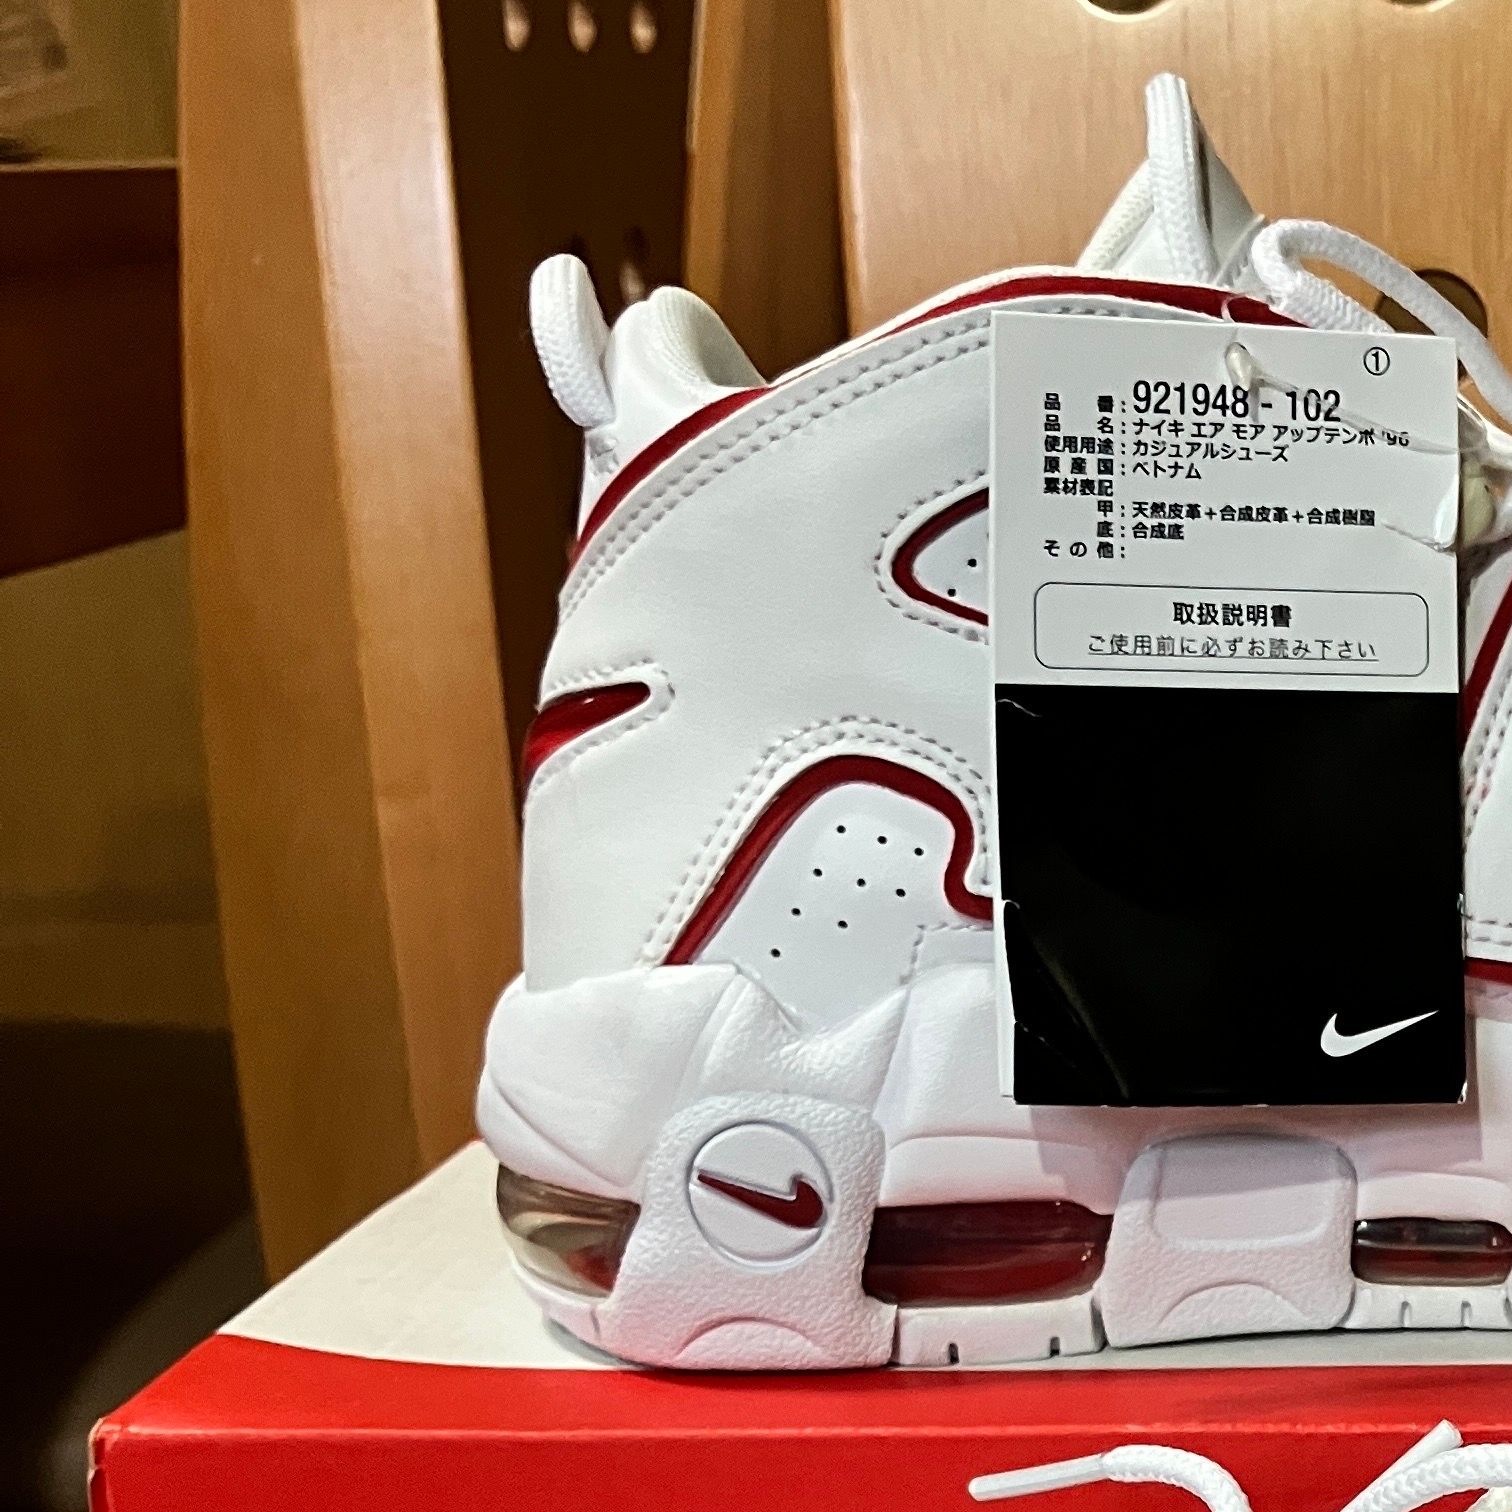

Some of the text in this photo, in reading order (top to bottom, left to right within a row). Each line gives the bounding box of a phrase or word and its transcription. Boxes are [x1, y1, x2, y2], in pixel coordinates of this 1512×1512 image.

[1132, 418, 1185, 436] ナイキ
[1190, 422, 1224, 439] エア
[1231, 424, 1265, 441] モア
[1272, 425, 1376, 446] アップテンポ
[1132, 440, 1290, 463] カジュアルシューズ
[1132, 462, 1202, 480] ベトナム
[1132, 522, 1185, 541] 合成底
[1172, 602, 1293, 629] 取扱説明書
[1088, 634, 1378, 662] ご使用前に必ずお読み下さい
